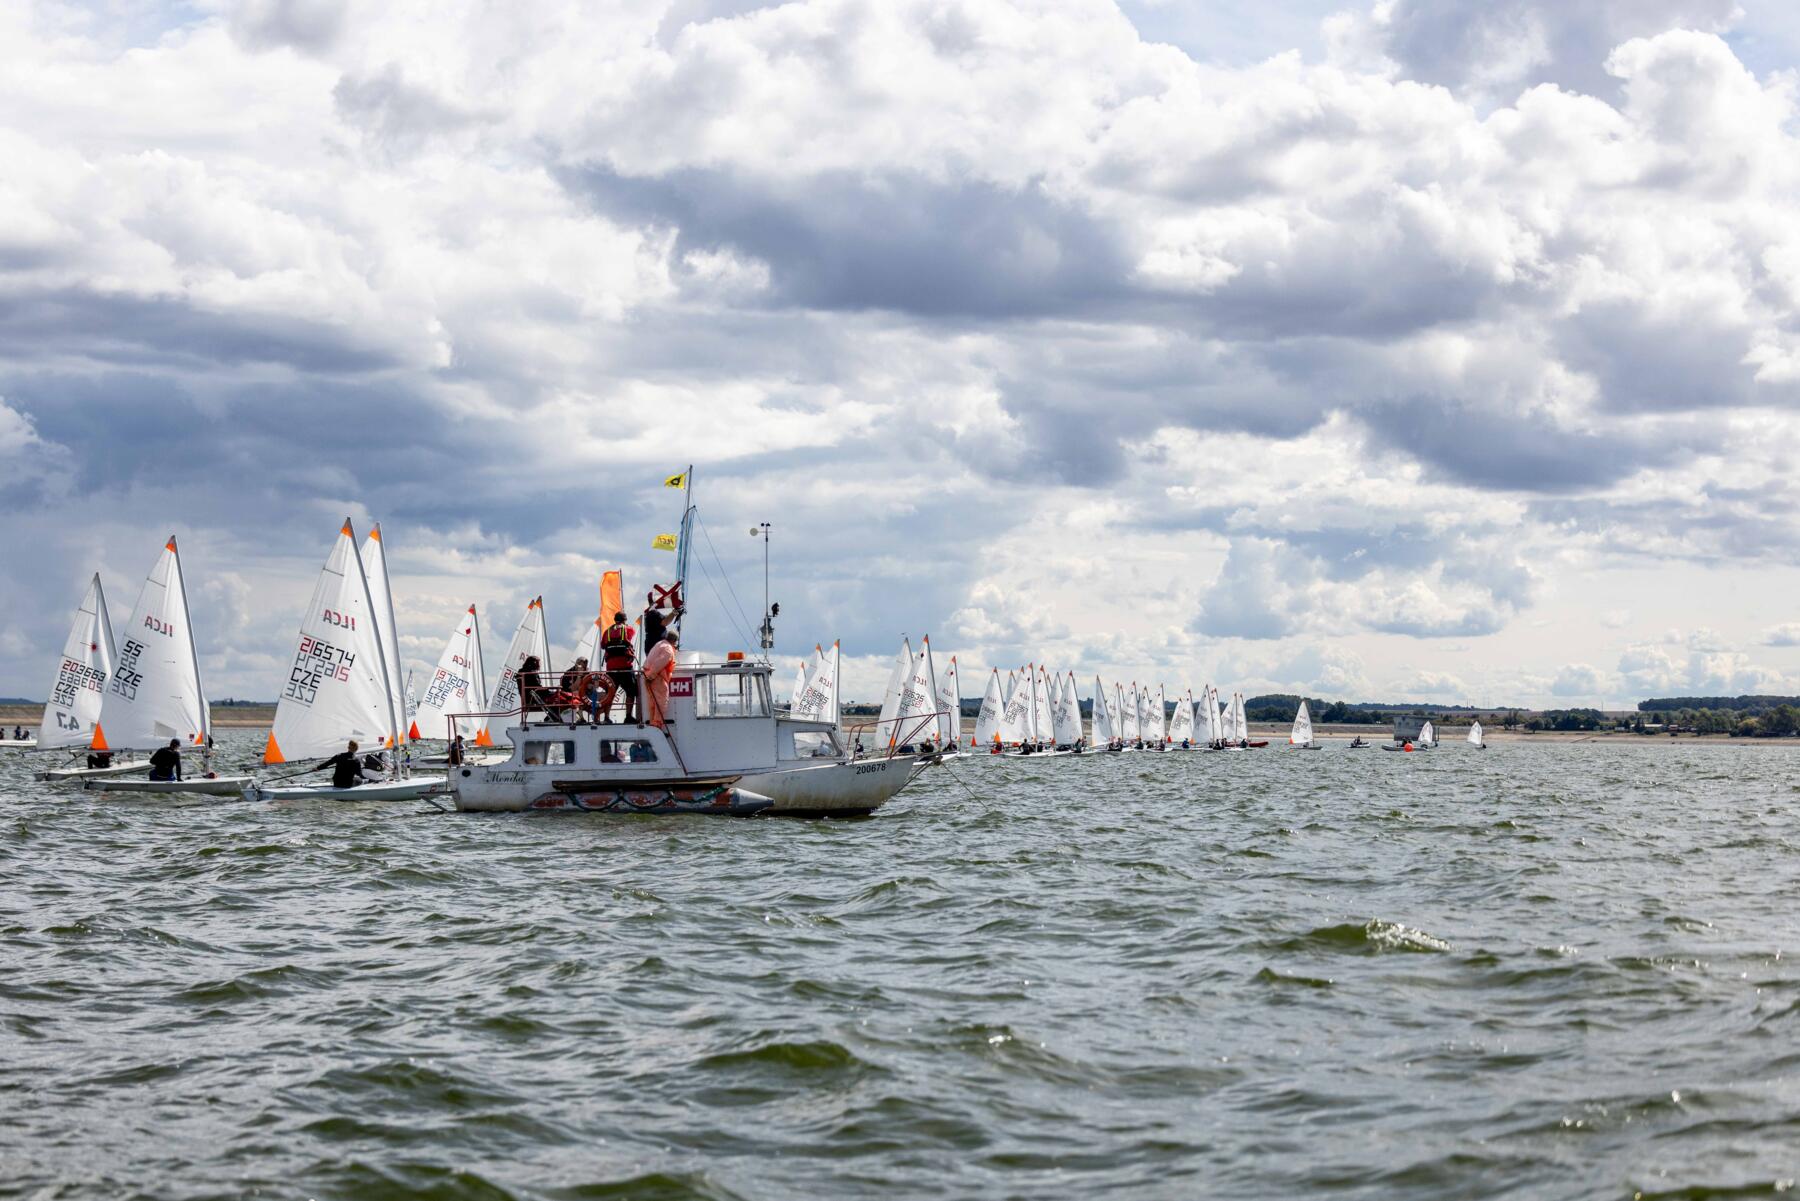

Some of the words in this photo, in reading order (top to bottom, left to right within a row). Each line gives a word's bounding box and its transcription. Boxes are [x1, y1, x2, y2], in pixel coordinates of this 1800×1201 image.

[123, 640, 144, 657] 55
[300, 637, 356, 667] 216574
[62, 660, 106, 682] 203663
[115, 666, 143, 687] CZE
[291, 667, 322, 689] CZE
[55, 681, 79, 696] CZE
[428, 686, 449, 700] CZE
[497, 687, 517, 703] CZE
[671, 682, 689, 692] HH
[856, 762, 886, 775] 200678
